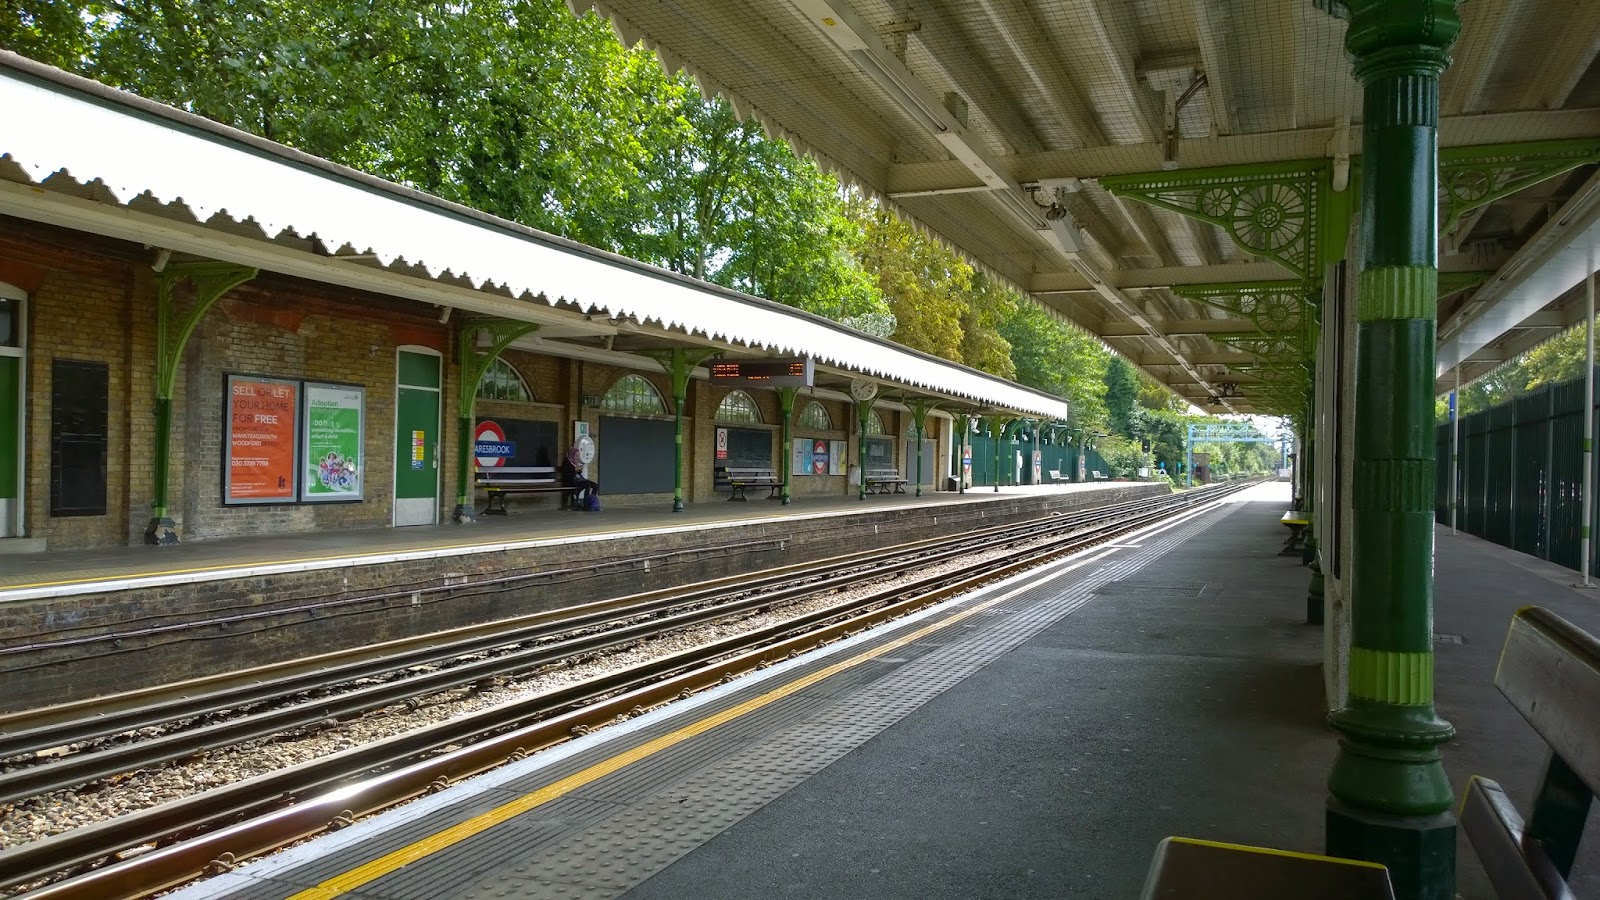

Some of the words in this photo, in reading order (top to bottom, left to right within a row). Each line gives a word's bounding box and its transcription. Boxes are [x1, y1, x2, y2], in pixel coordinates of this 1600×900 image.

[233, 385, 256, 396] SELL
[258, 387, 272, 397] OR
[273, 388, 290, 398] LET
[233, 400, 260, 410] YOUR
[262, 401, 289, 412] HOME
[233, 413, 254, 423] FOR
[254, 414, 279, 424] FREE
[475, 444, 510, 454] ARESBROOK
